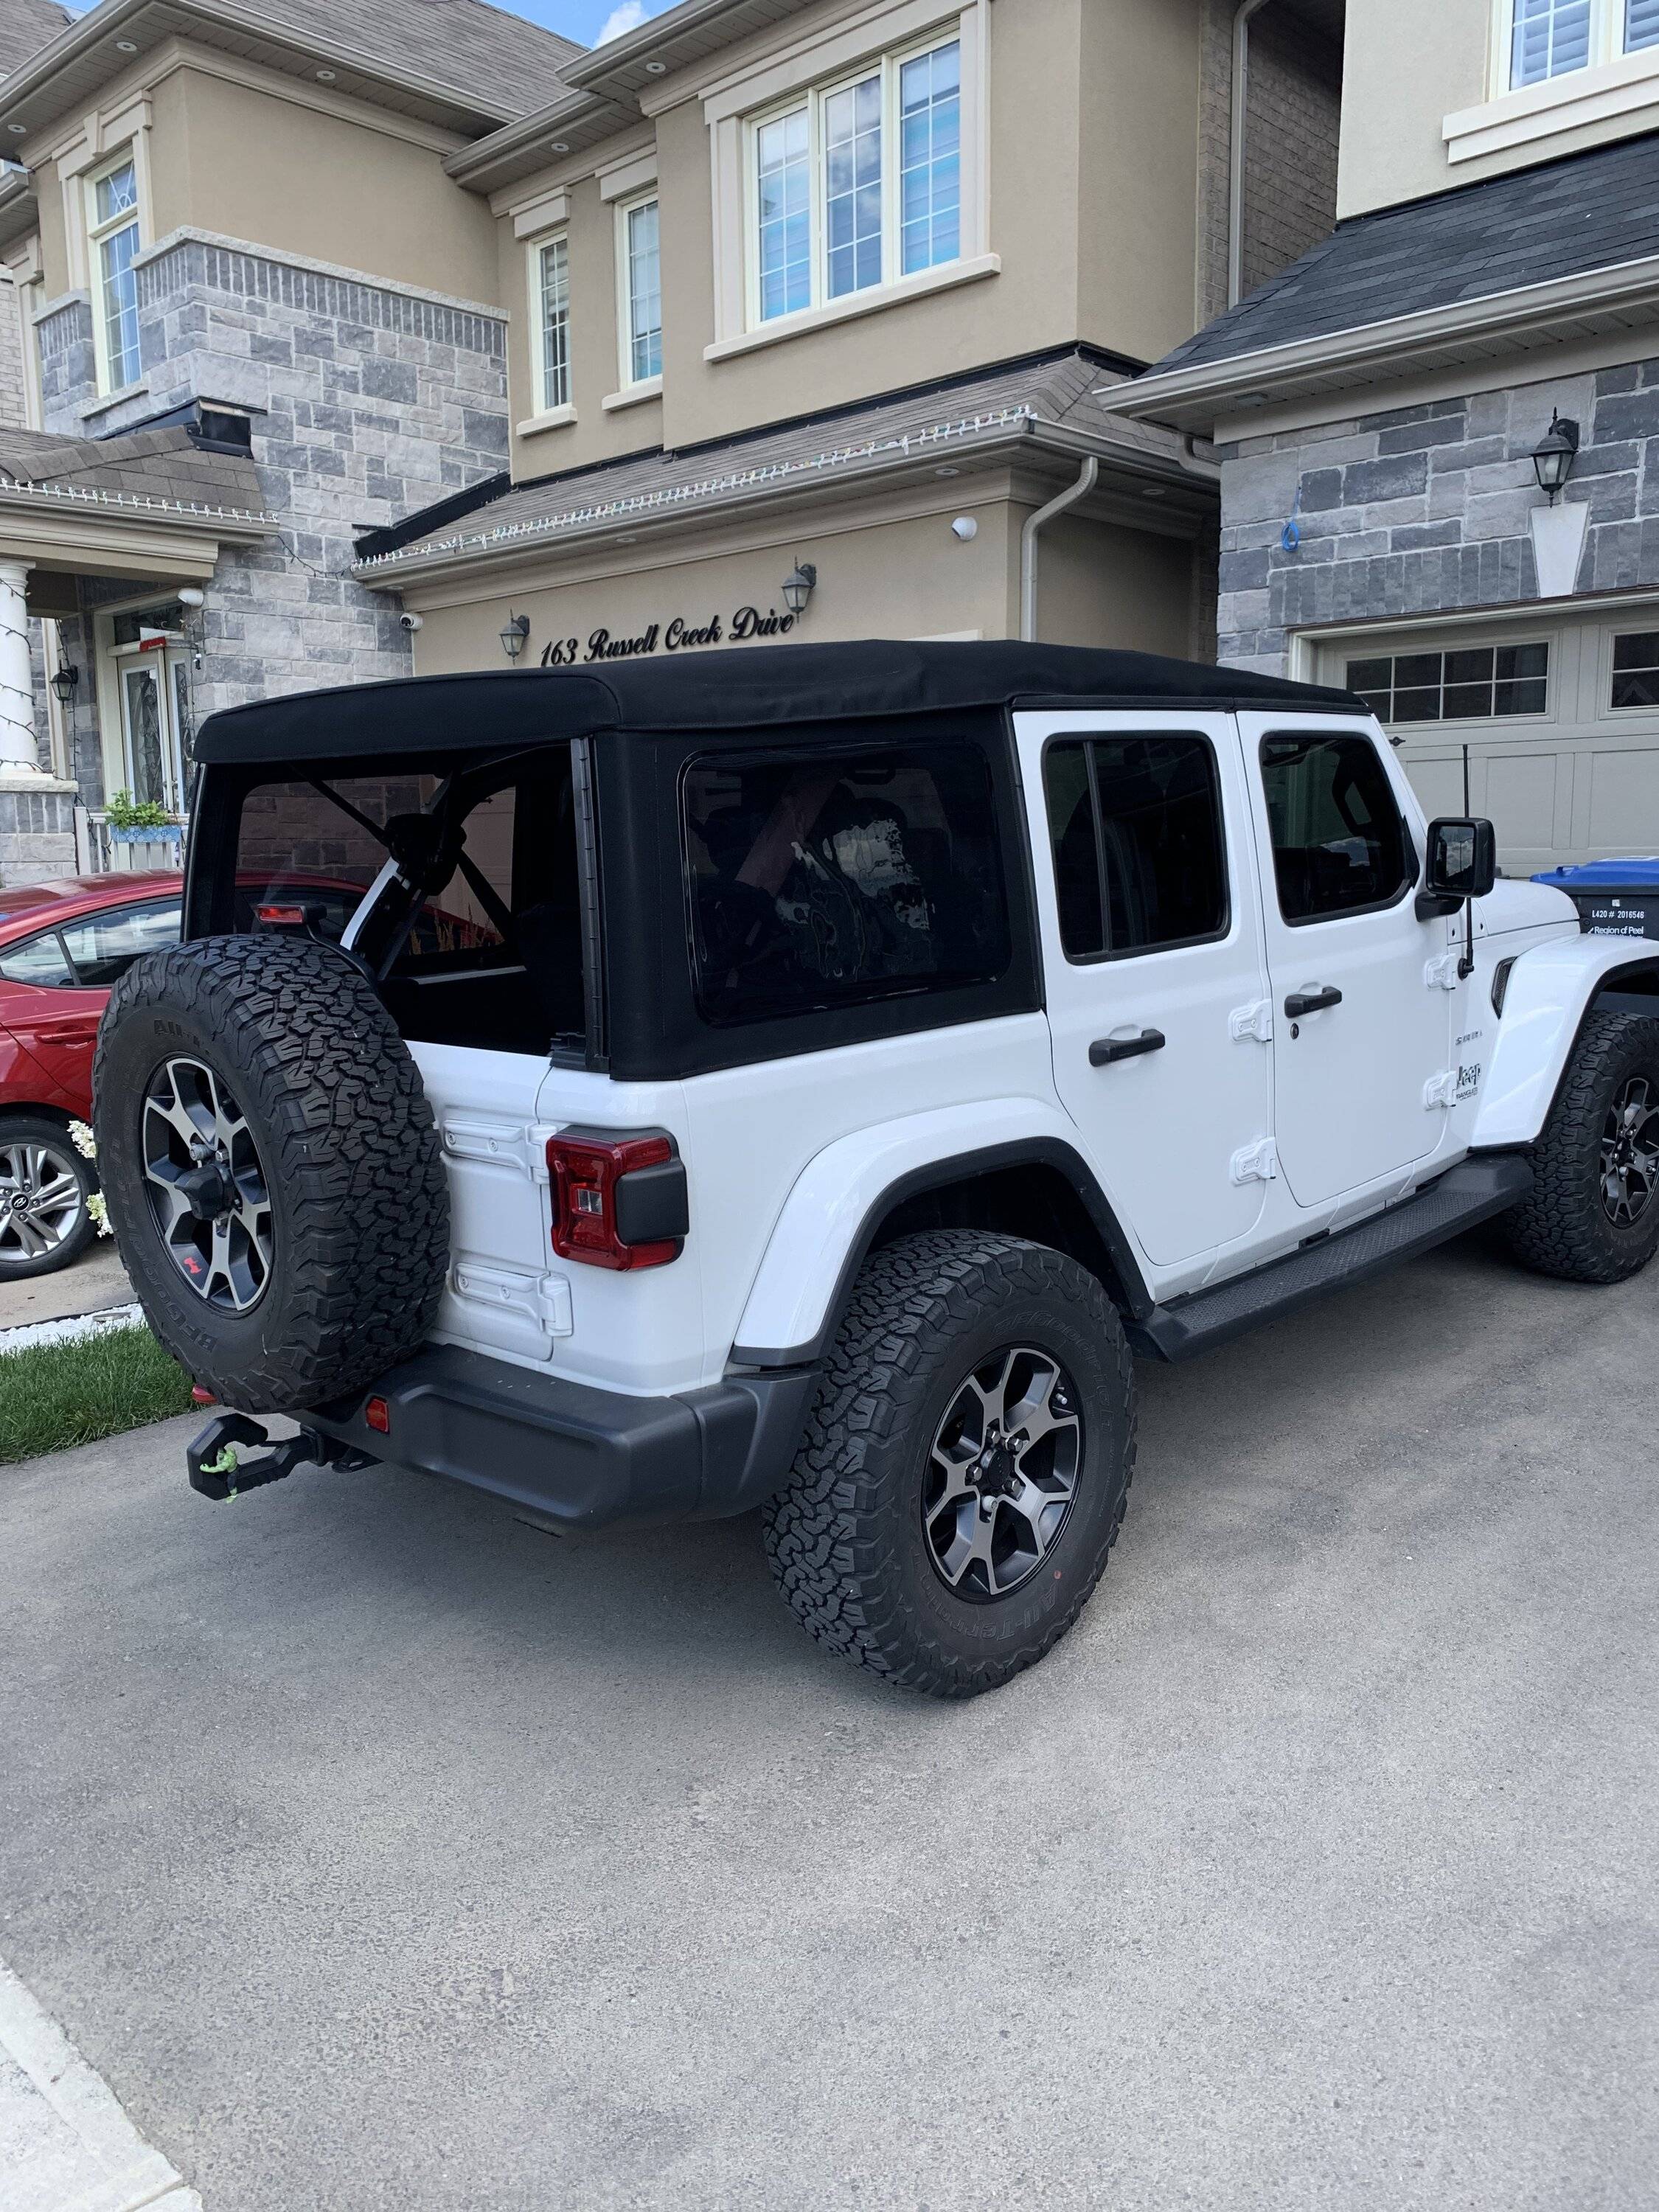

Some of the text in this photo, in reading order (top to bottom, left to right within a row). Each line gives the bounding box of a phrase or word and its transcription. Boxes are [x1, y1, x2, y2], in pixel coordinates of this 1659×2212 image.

[540, 605, 794, 667] 163 Russell Creek Drive
[1592, 910, 1607, 918] L420
[1617, 910, 1644, 919] 2016546
[1594, 926, 1644, 934] Region of Peel
[1456, 1063, 1481, 1090] Jeep
